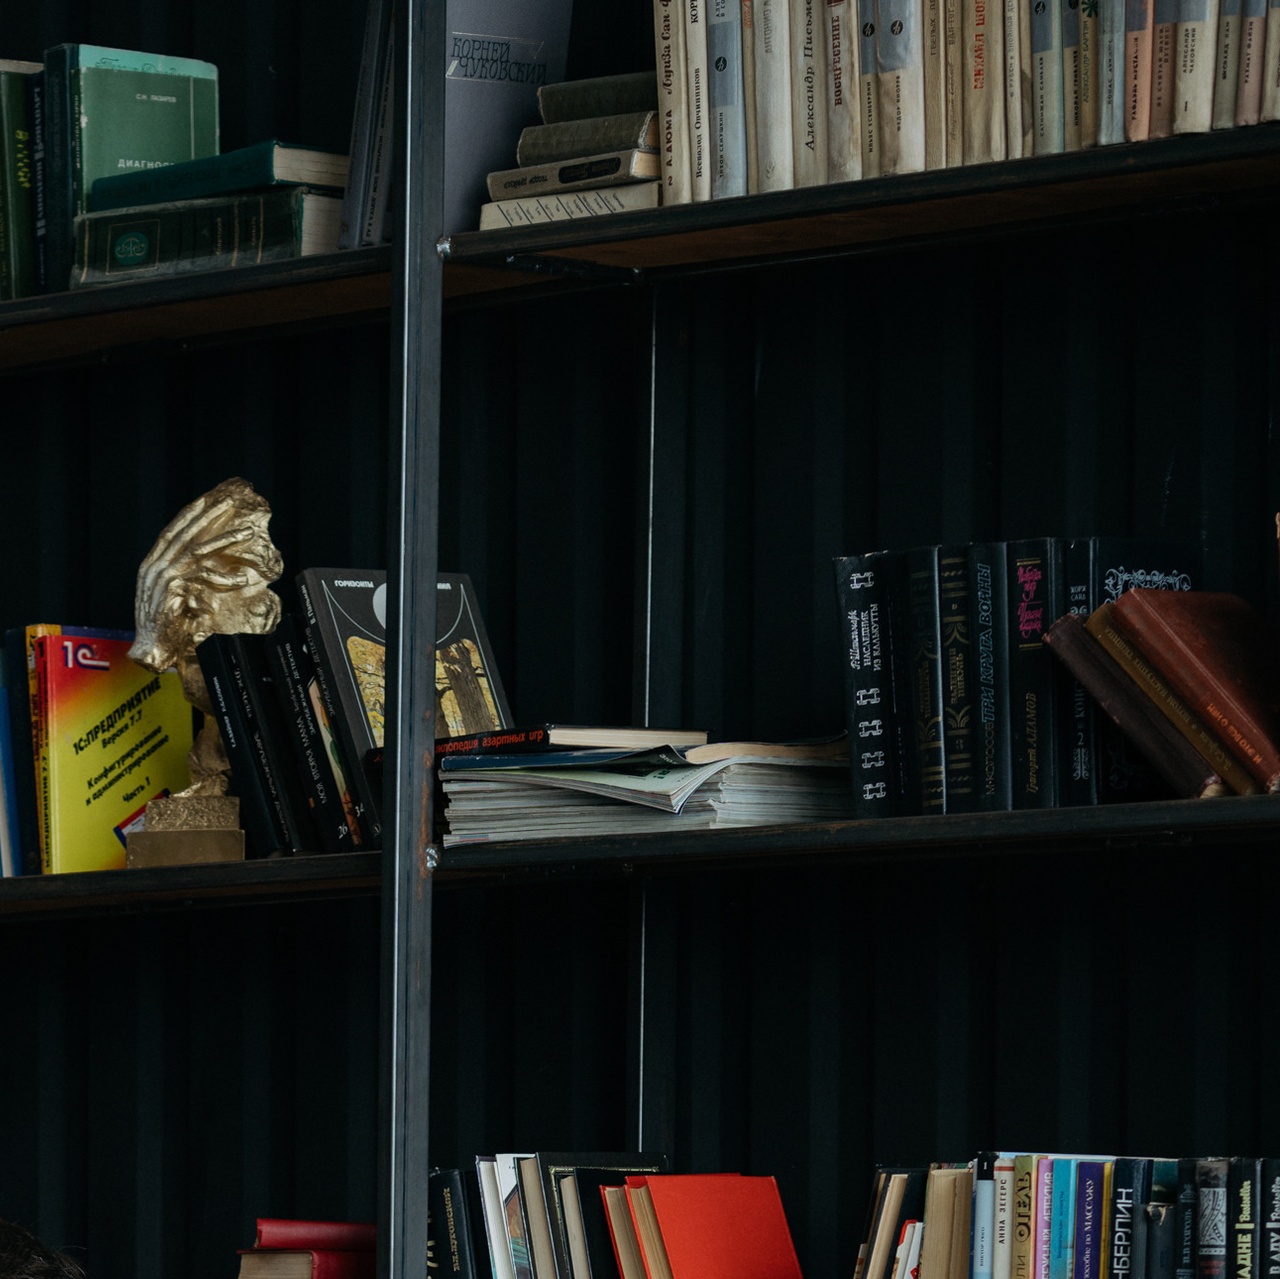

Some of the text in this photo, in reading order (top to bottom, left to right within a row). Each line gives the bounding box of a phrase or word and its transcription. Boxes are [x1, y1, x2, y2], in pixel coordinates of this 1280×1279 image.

[450, 32, 510, 61] КОРНЕЙ
[459, 55, 547, 84] ЧУКОВСКИЙ
[832, 16, 843, 106] ВОСКРЕСЕНИЕ
[974, 34, 985, 89] МИХАИЛ
[693, 68, 702, 129] Овчинников
[805, 66, 815, 150] Александр
[285, 643, 300, 680] ДЕТЕКТИВ
[861, 611, 871, 666] НАСЛЕДНИК
[870, 603, 881, 670] ИЗ КАЛЬКУТТЫ
[978, 563, 995, 722] ТРИ КРУГА ВОЙНЫ
[73, 677, 161, 756] 1С:ПРЕДПРИЯТИЕ
[102, 709, 142, 749] Версия 7.7
[295, 715, 311, 746] МАМА
[483, 730, 544, 747] азартных игр
[1026, 692, 1036, 746] АДАМОВ
[87, 725, 163, 790] Конфигурирование
[92, 735, 169, 801] администрирование
[122, 783, 145, 803] Часть
[999, 1179, 1007, 1213] ЗЕГЕРС
[1014, 1172, 1031, 1243] ОТЕЛЬ
[1084, 1178, 1094, 1231] МАССАЖУ
[1237, 1180, 1252, 1222] Bestseller
[1084, 1234, 1092, 1244] по
[1268, 1232, 1280, 1261] АДУ
[1269, 1264, 1280, 1274] В
